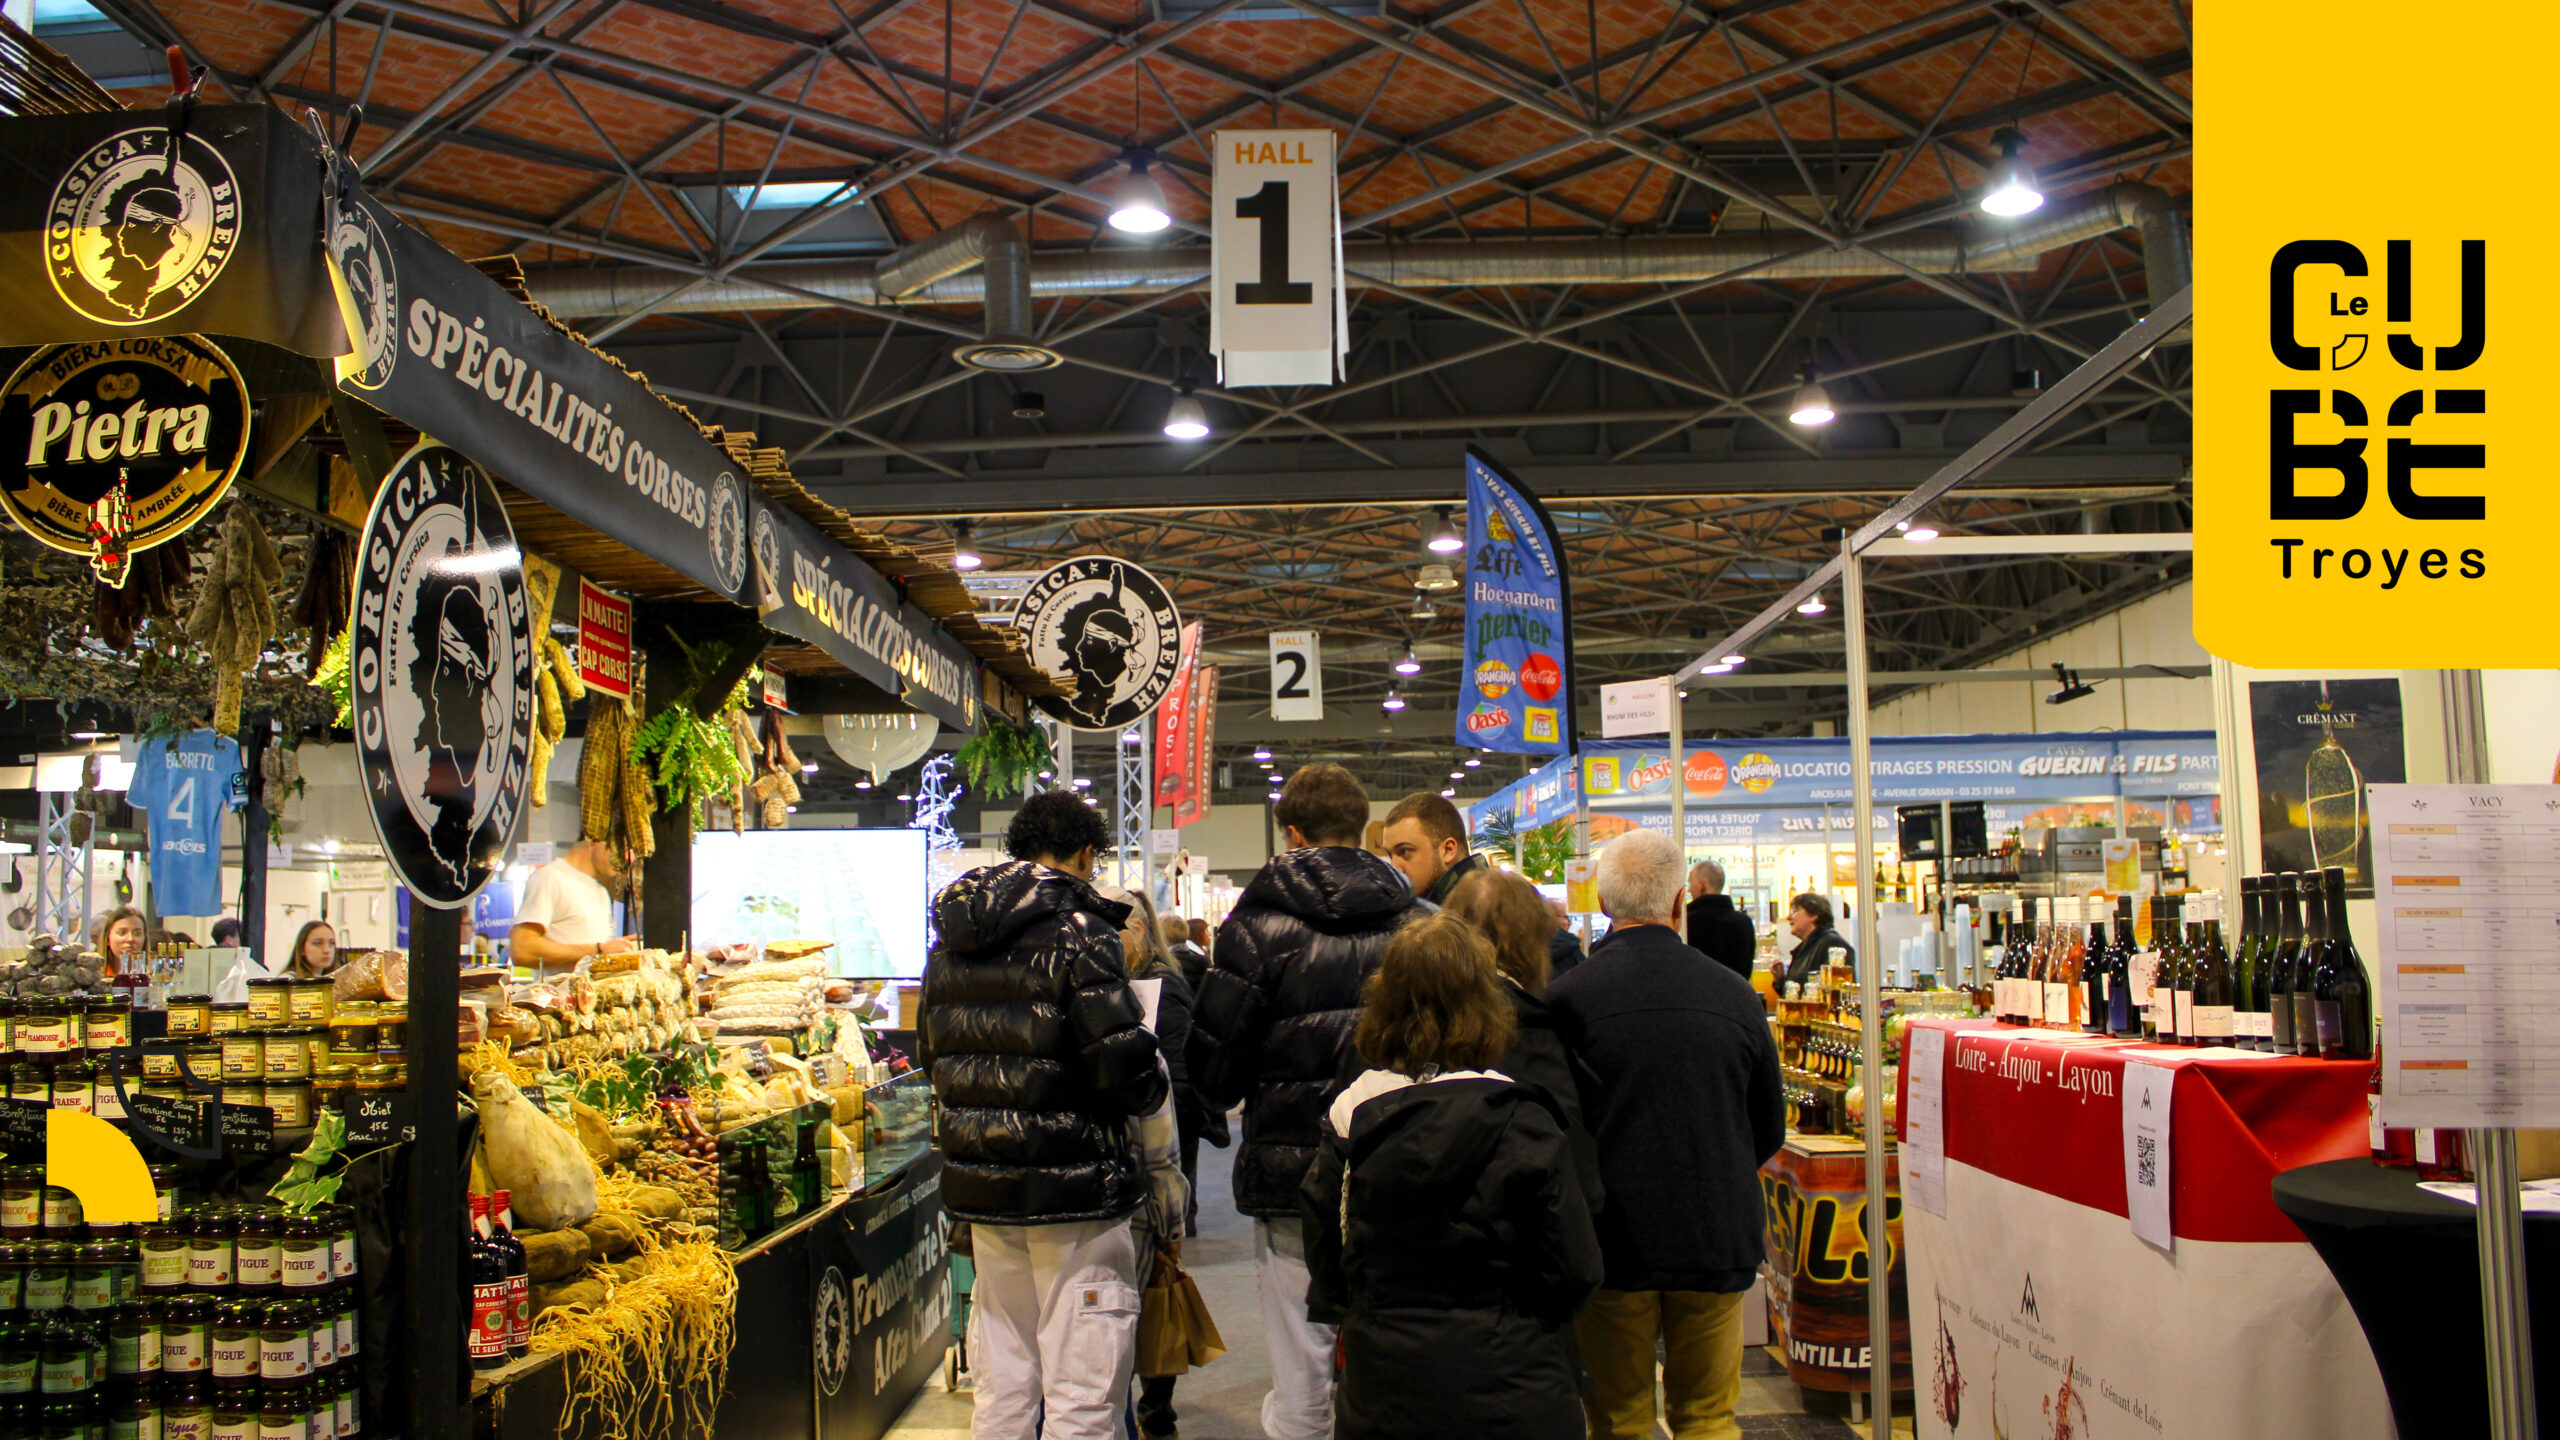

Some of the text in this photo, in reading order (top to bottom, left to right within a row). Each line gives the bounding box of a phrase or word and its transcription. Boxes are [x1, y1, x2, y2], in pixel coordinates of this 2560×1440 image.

[1235, 141, 1314, 165] HALL
[51, 138, 137, 261] CORSICA
[177, 180, 235, 299] BREIZH
[1235, 180, 1313, 305] 1
[376, 281, 396, 380] BREIZH
[406, 297, 707, 530] SPÉCIALITÉS CORSES
[25, 399, 210, 467] Pietra
[46, 483, 187, 524] BIÈRE AMBRÉE
[359, 460, 439, 751] CORSICA
[1016, 564, 1086, 667] ORSICA
[793, 550, 912, 677] SPÉCIALITÉS
[911, 637, 959, 706] CORSES
[1276, 636, 1305, 647] HALL
[582, 645, 628, 683] CAP CORSE
[1131, 605, 1178, 713] BREIZH
[1276, 651, 1310, 699] 2
[1474, 668, 1518, 686] ORANGINA
[492, 583, 531, 842] BREIZH
[1467, 705, 1512, 732] Oasis
[2296, 711, 2357, 725] CRÉMANT
[165, 752, 215, 772] BARRETO
[1730, 763, 1782, 784] ORANGINA
[1784, 759, 2013, 777] LOCATIO TIRAGES PRESSION
[2018, 753, 2178, 776] GUERIN & FILS
[167, 777, 195, 829] 4
[1883, 788, 1917, 798] AVENUE
[2468, 796, 2504, 808] VACY
[1954, 1036, 1987, 1073] Loire
[1998, 1042, 2042, 1093] Anjou
[2057, 1050, 2114, 1105] Layon
[220, 1112, 260, 1125] onfiture
[360, 1100, 392, 1117] Miel
[148, 1256, 183, 1267] FIGUE
[284, 1259, 316, 1271] FIGUE
[1968, 1306, 1991, 1335] Coteaux
[2001, 1324, 2021, 1350] Layon
[214, 1350, 246, 1361] FIGUE
[262, 1351, 295, 1362] FIGUE
[482, 1345, 500, 1354] SEUL
[2028, 1339, 2061, 1374] Cabernet
[2100, 1378, 2163, 1434] Crémant de Loire
